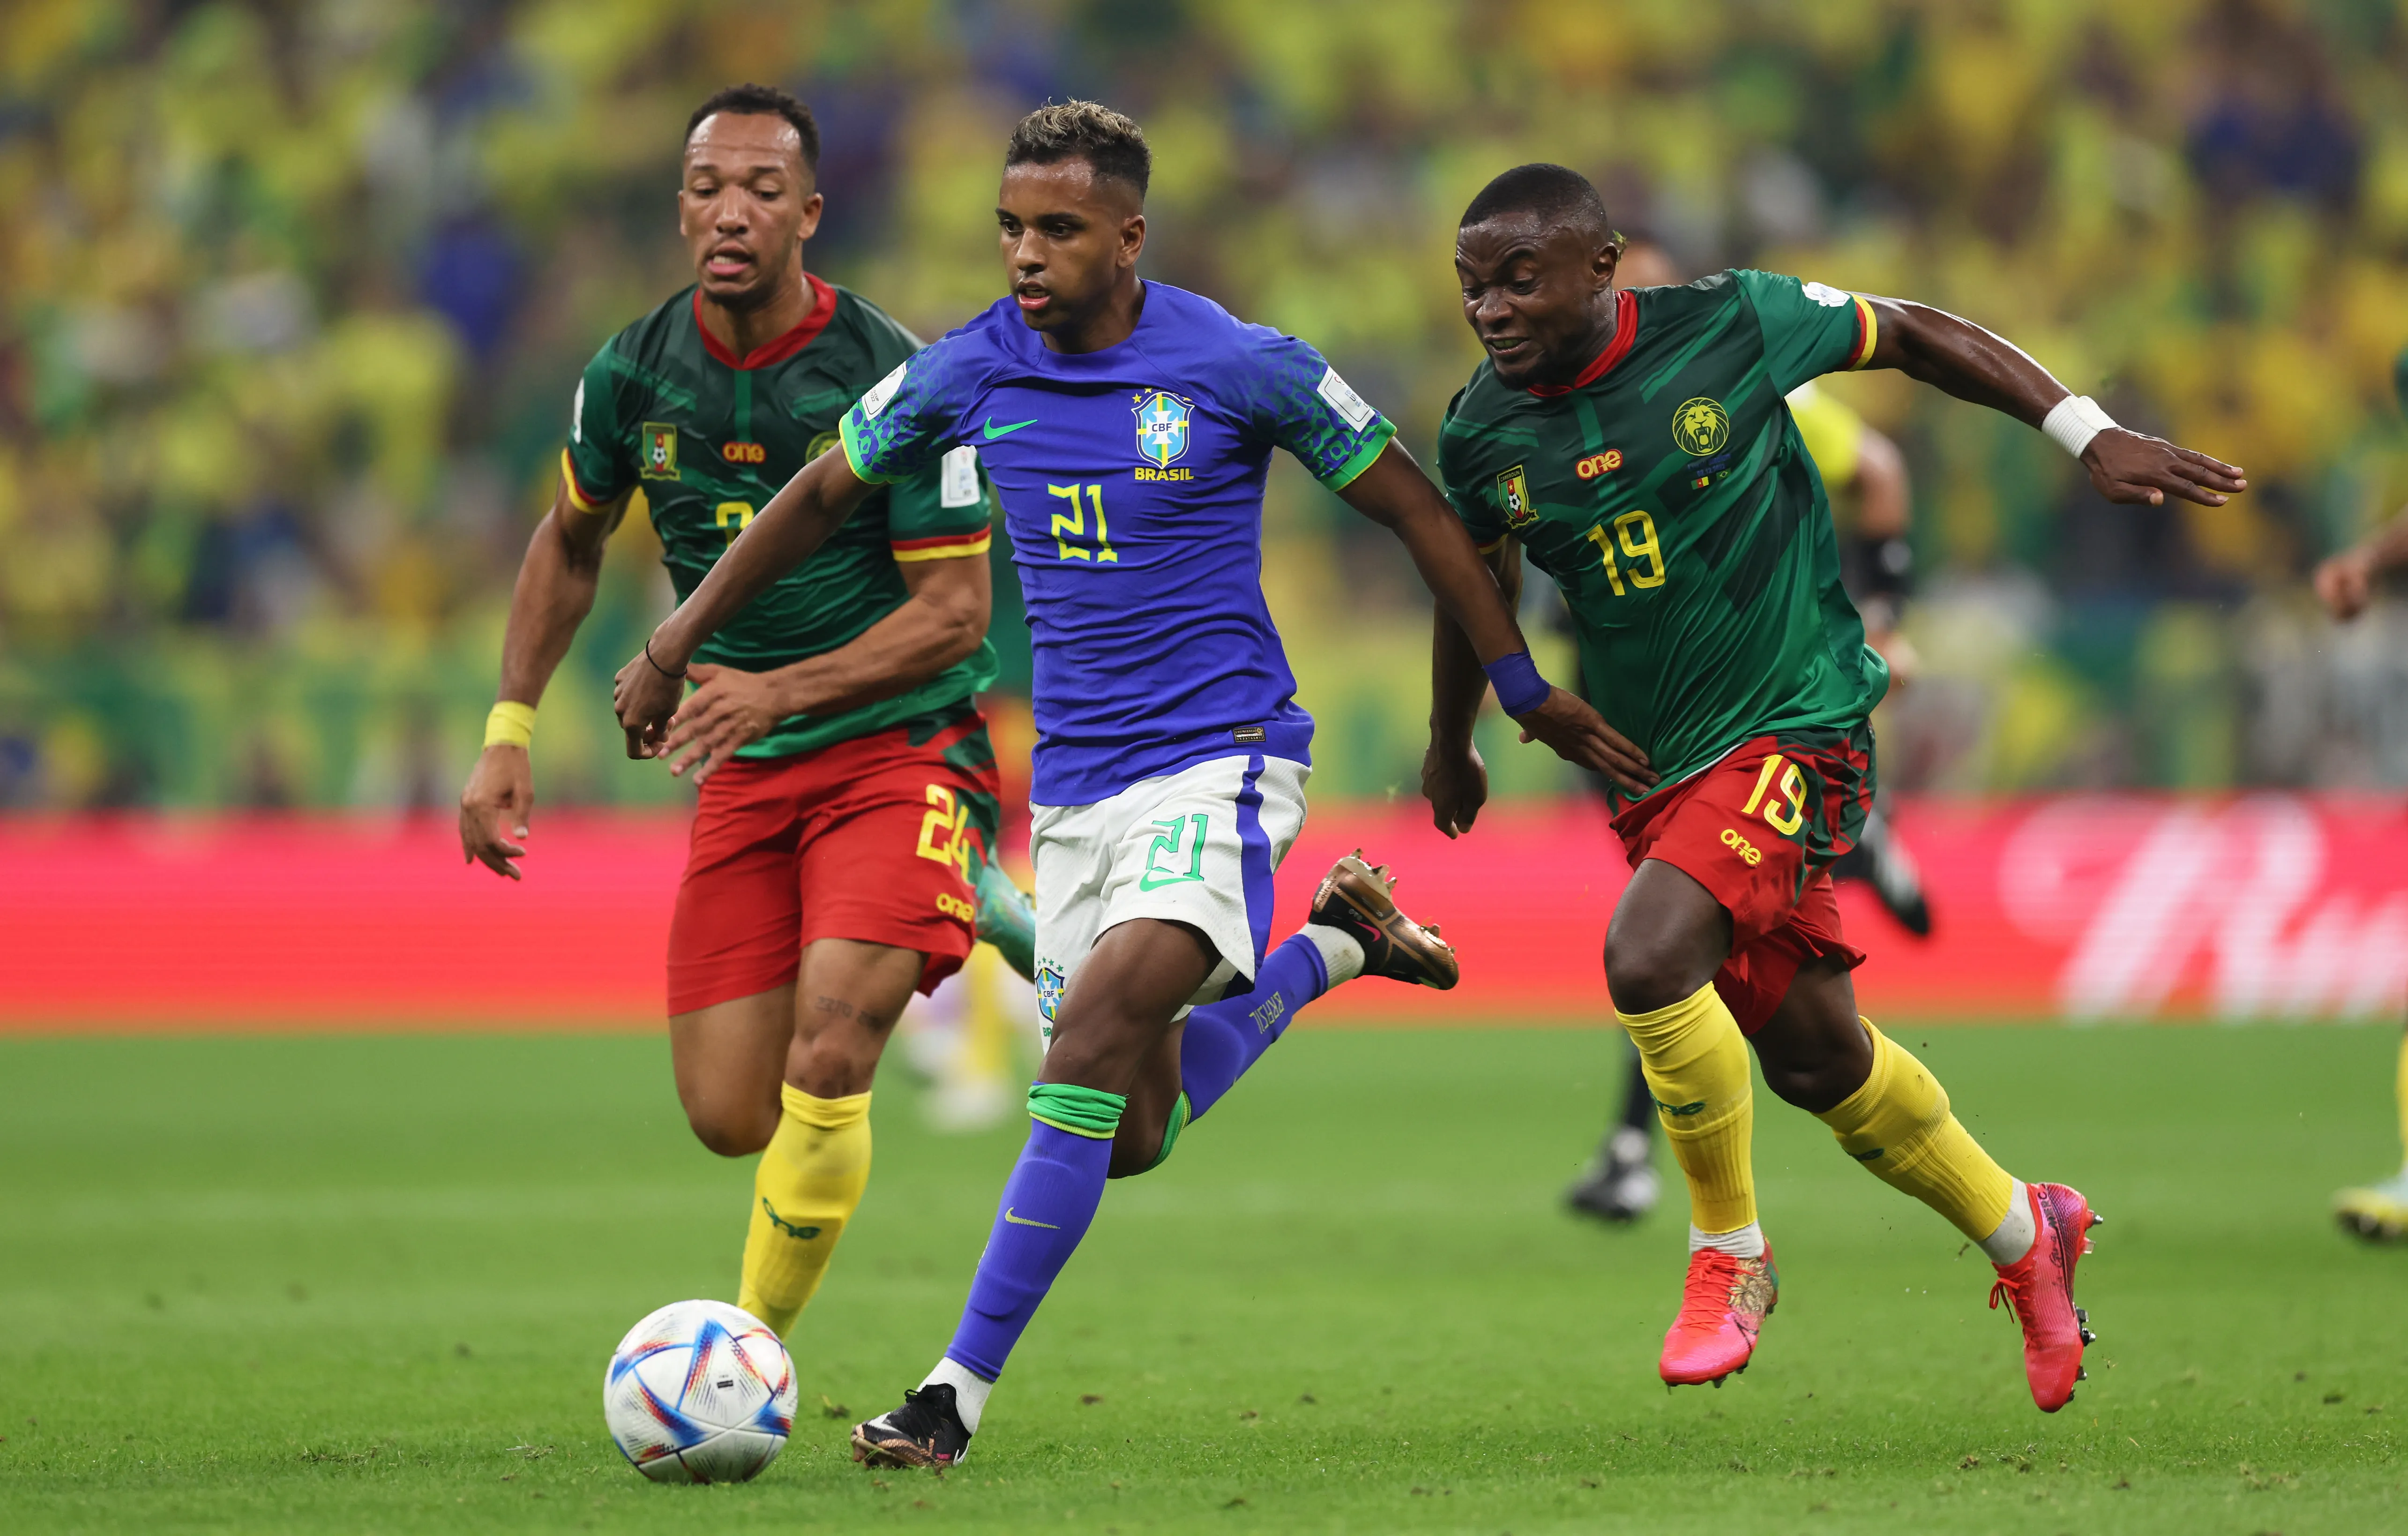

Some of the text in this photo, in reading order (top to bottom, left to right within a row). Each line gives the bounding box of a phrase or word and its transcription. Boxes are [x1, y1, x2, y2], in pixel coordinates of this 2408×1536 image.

[1152, 423, 1172, 432] CBF
[723, 443, 765, 463] one
[1577, 450, 1621, 478] one
[1135, 467, 1195, 481] BRASIL
[1500, 470, 1520, 482] CAMEROUN
[1047, 483, 1118, 563] 21
[1585, 510, 1666, 596] 19
[1741, 754, 1808, 835] 19
[916, 783, 970, 884] 24
[1146, 814, 1208, 882] 21
[1720, 829, 1762, 866] one
[936, 893, 974, 922] one
